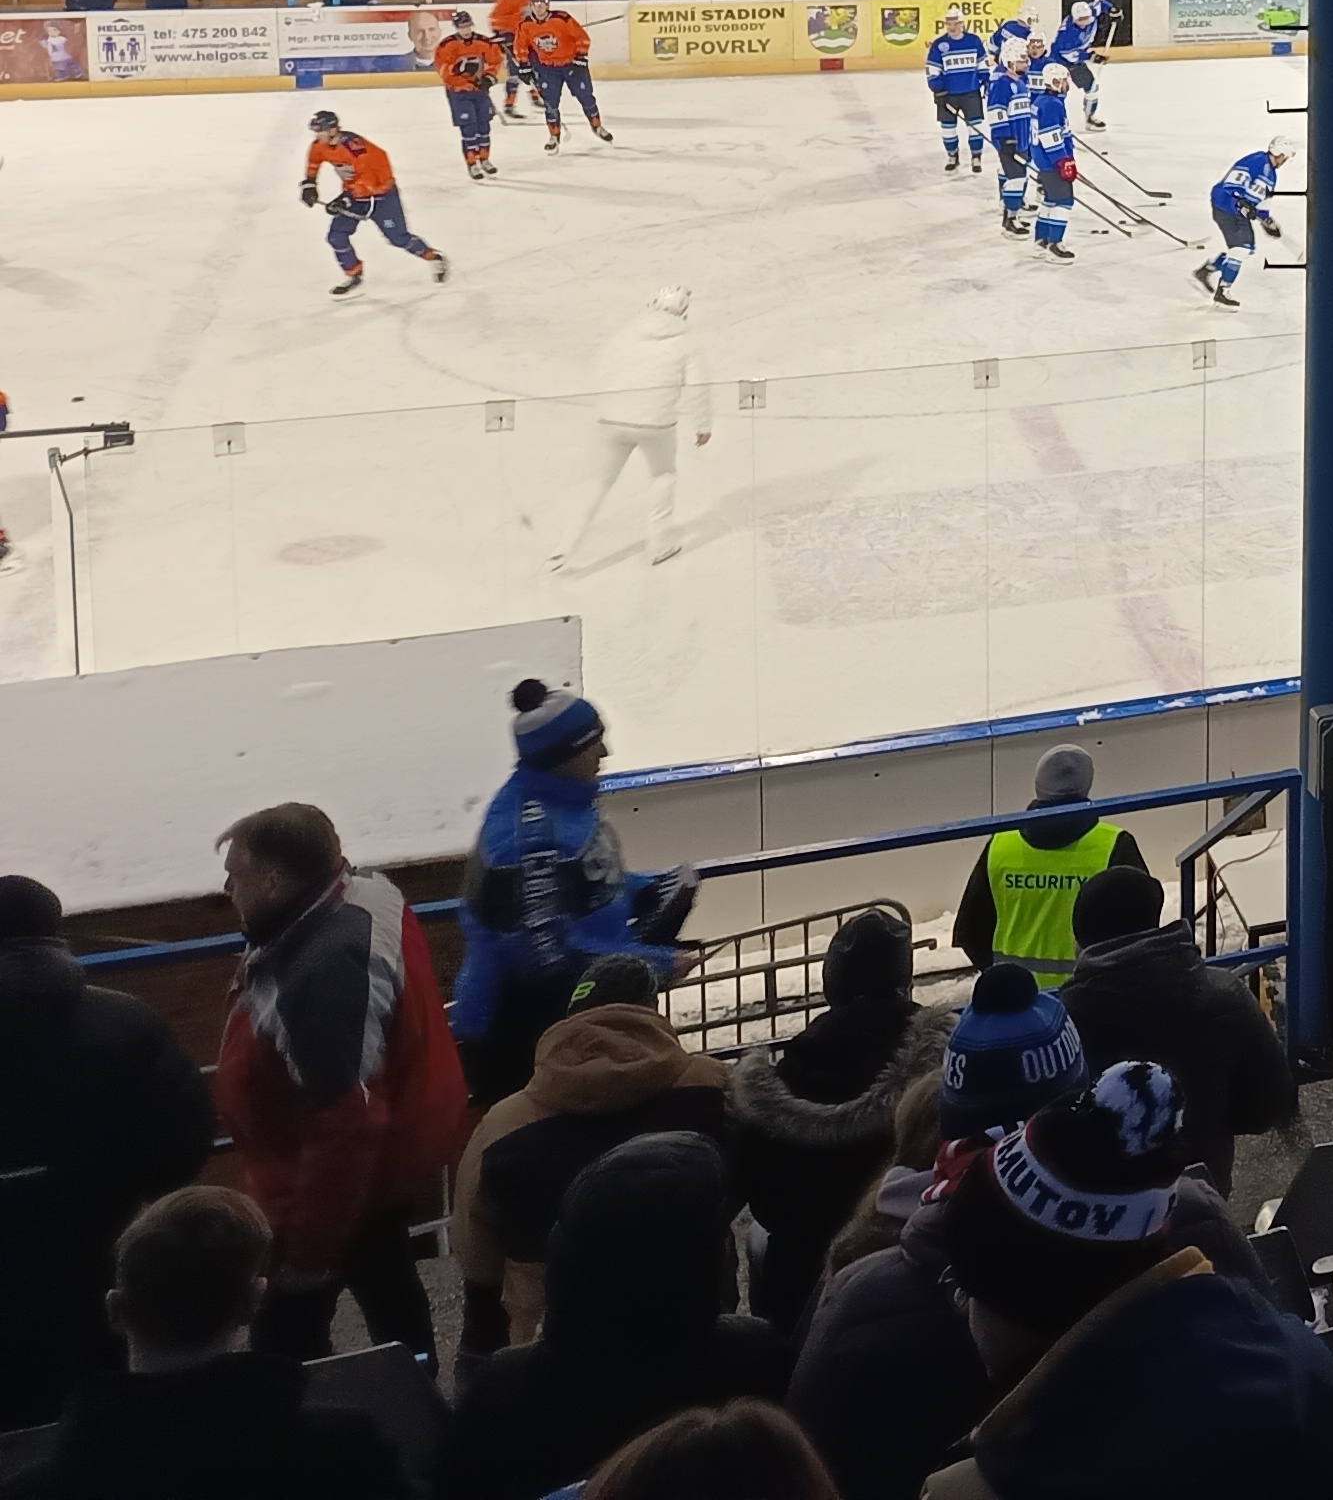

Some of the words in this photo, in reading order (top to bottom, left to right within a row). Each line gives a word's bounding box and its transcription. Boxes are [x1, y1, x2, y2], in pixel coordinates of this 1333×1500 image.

[637, 7, 696, 24] ZIMNÍ
[700, 7, 786, 22] STADION
[97, 23, 146, 33] HELGOS
[153, 28, 177, 40] tel:
[181, 28, 208, 39] 475
[211, 27, 238, 39] 200
[241, 26, 268, 38] 842
[657, 23, 701, 35] JIŘÍHO
[704, 22, 766, 33] SVOBODY
[935, 18, 1005, 35] PVRLY
[313, 34, 341, 43] PETR
[343, 31, 399, 42] KOSTOVIČ
[685, 38, 771, 56] POVRLY
[154, 49, 270, 64] www.helgos.cz
[1004, 873, 1089, 891] SECURITY
